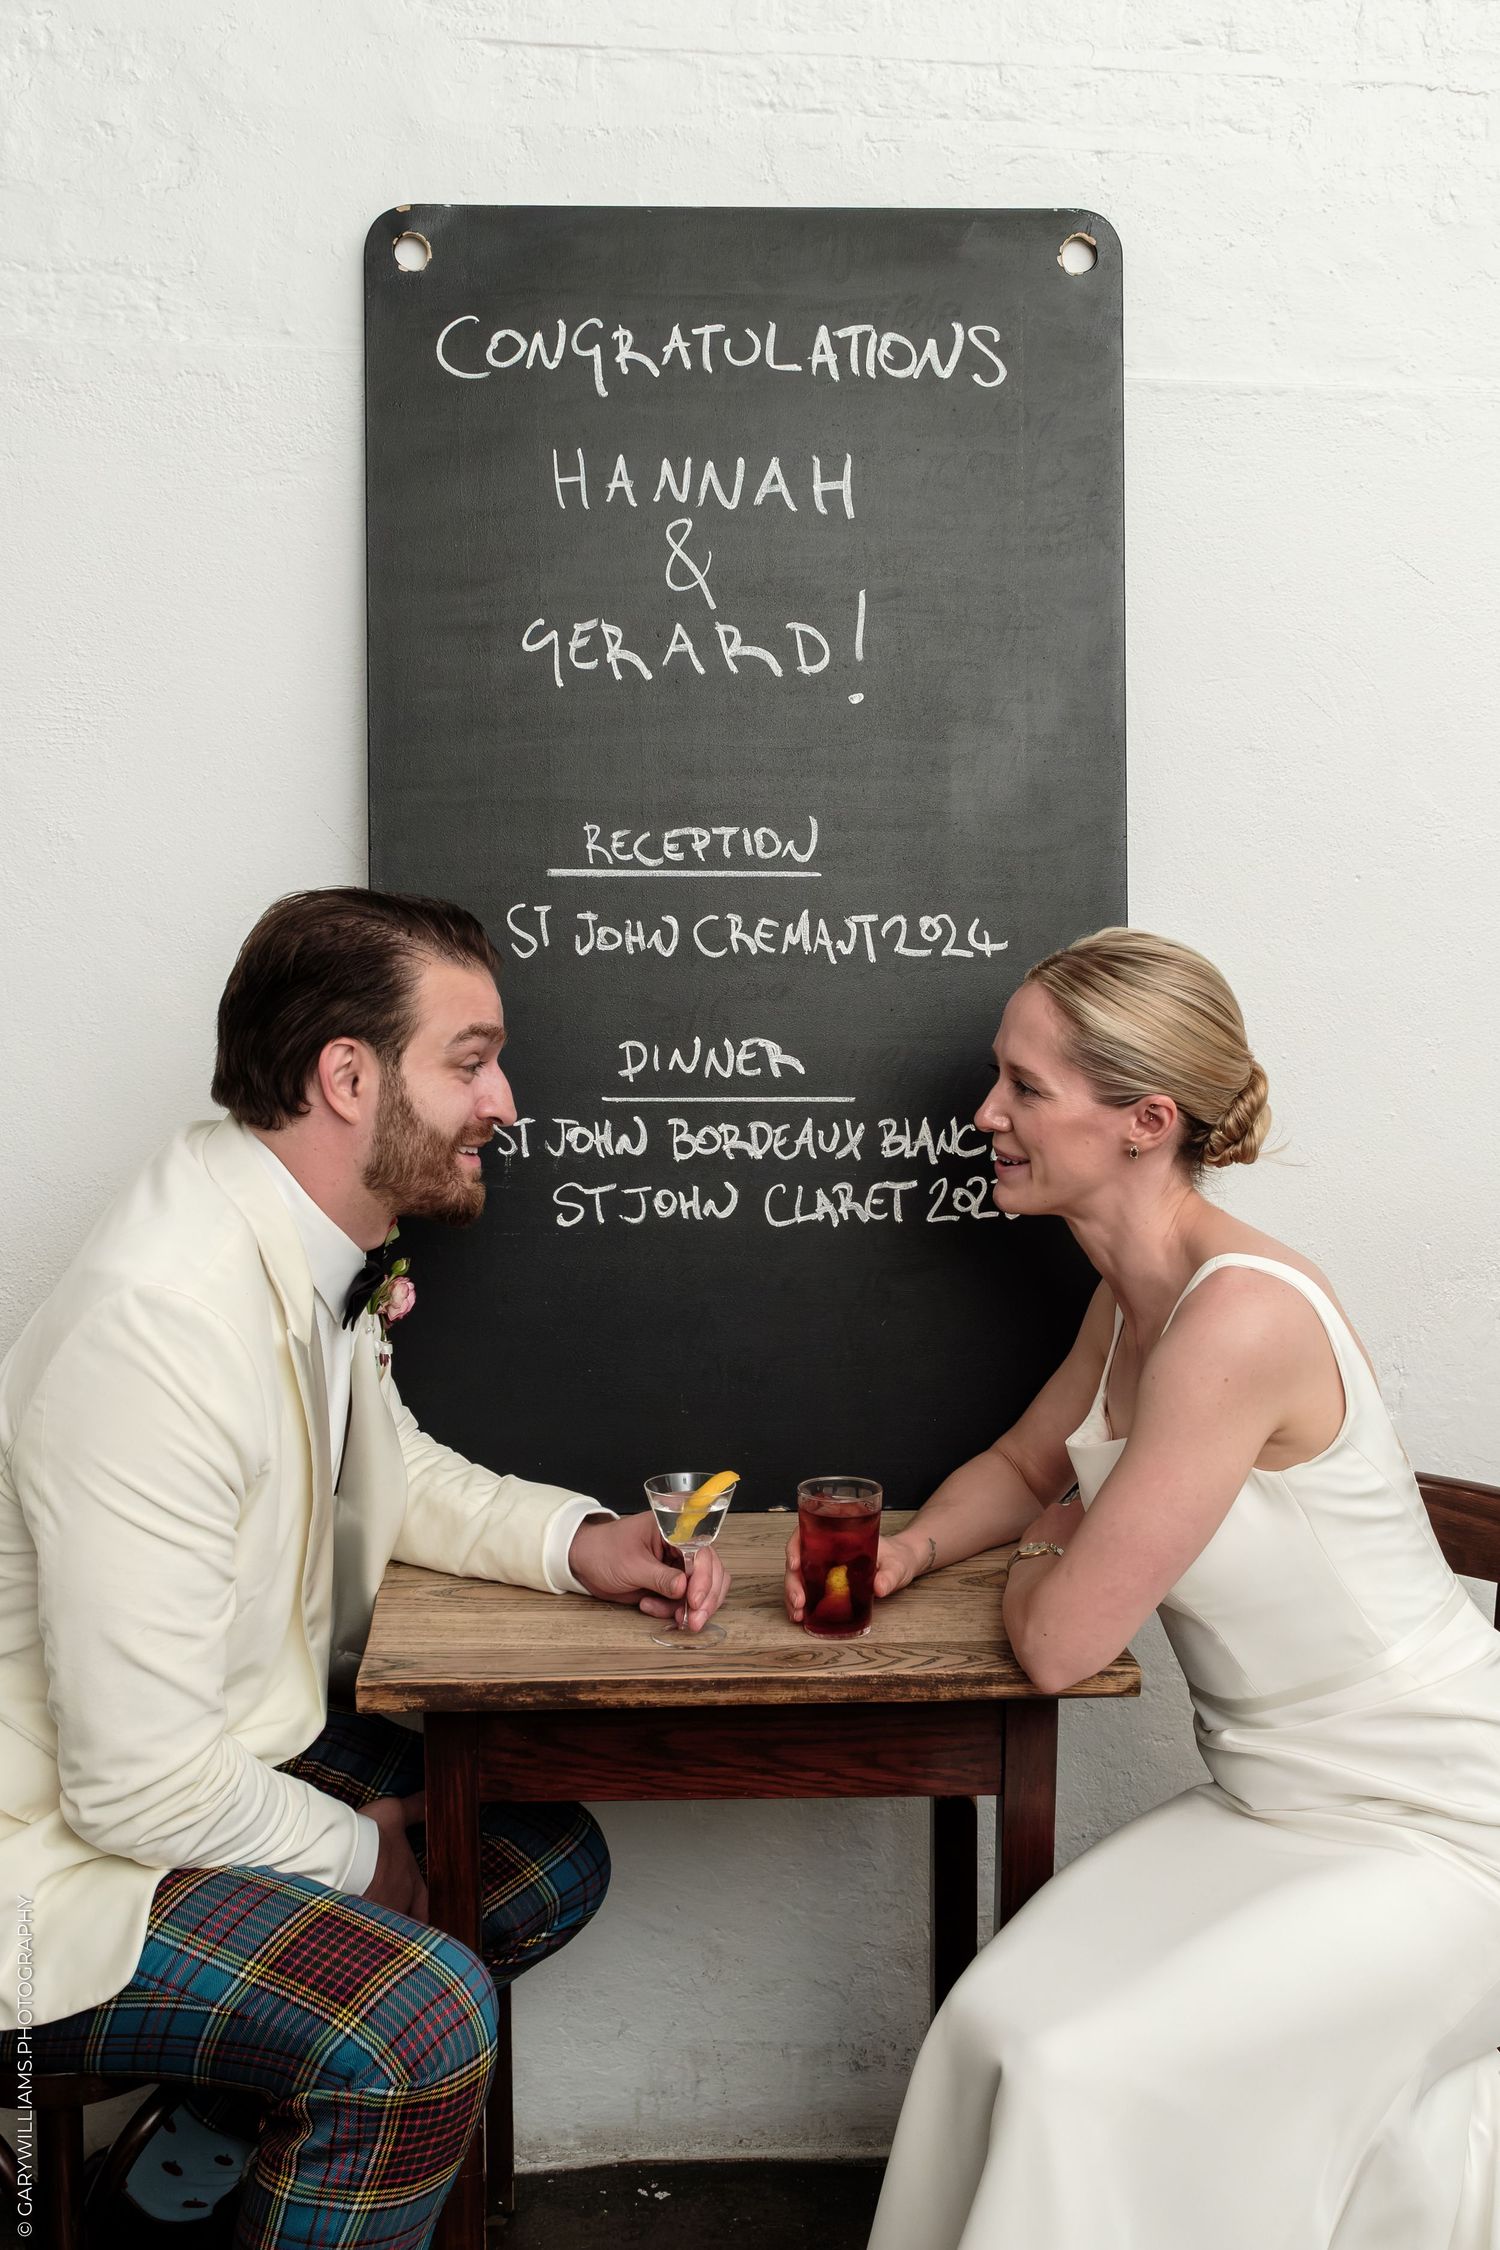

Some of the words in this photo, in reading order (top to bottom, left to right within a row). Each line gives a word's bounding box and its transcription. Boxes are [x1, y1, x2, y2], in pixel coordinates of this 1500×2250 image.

[435, 315, 1008, 398] CONGRATULATIONS
[552, 447, 856, 521] HANNAH
[664, 516, 717, 611] &
[521, 588, 867, 705] GERARD!
[582, 815, 819, 867] RECEPTION
[506, 903, 552, 959] ST
[574, 910, 680, 958] JOHN
[692, 908, 879, 965] CREMANT
[881, 913, 1009, 959] 2024
[617, 1035, 806, 1083] DINNER
[545, 1115, 648, 1159] JOHN
[666, 1116, 866, 1163] BORDEAUX
[877, 1116, 987, 1165] BLANC
[552, 1181, 617, 1228] ST
[618, 1181, 739, 1224] JOHN
[764, 1180, 918, 1228] CLARET
[926, 1176, 1020, 1223] 202
